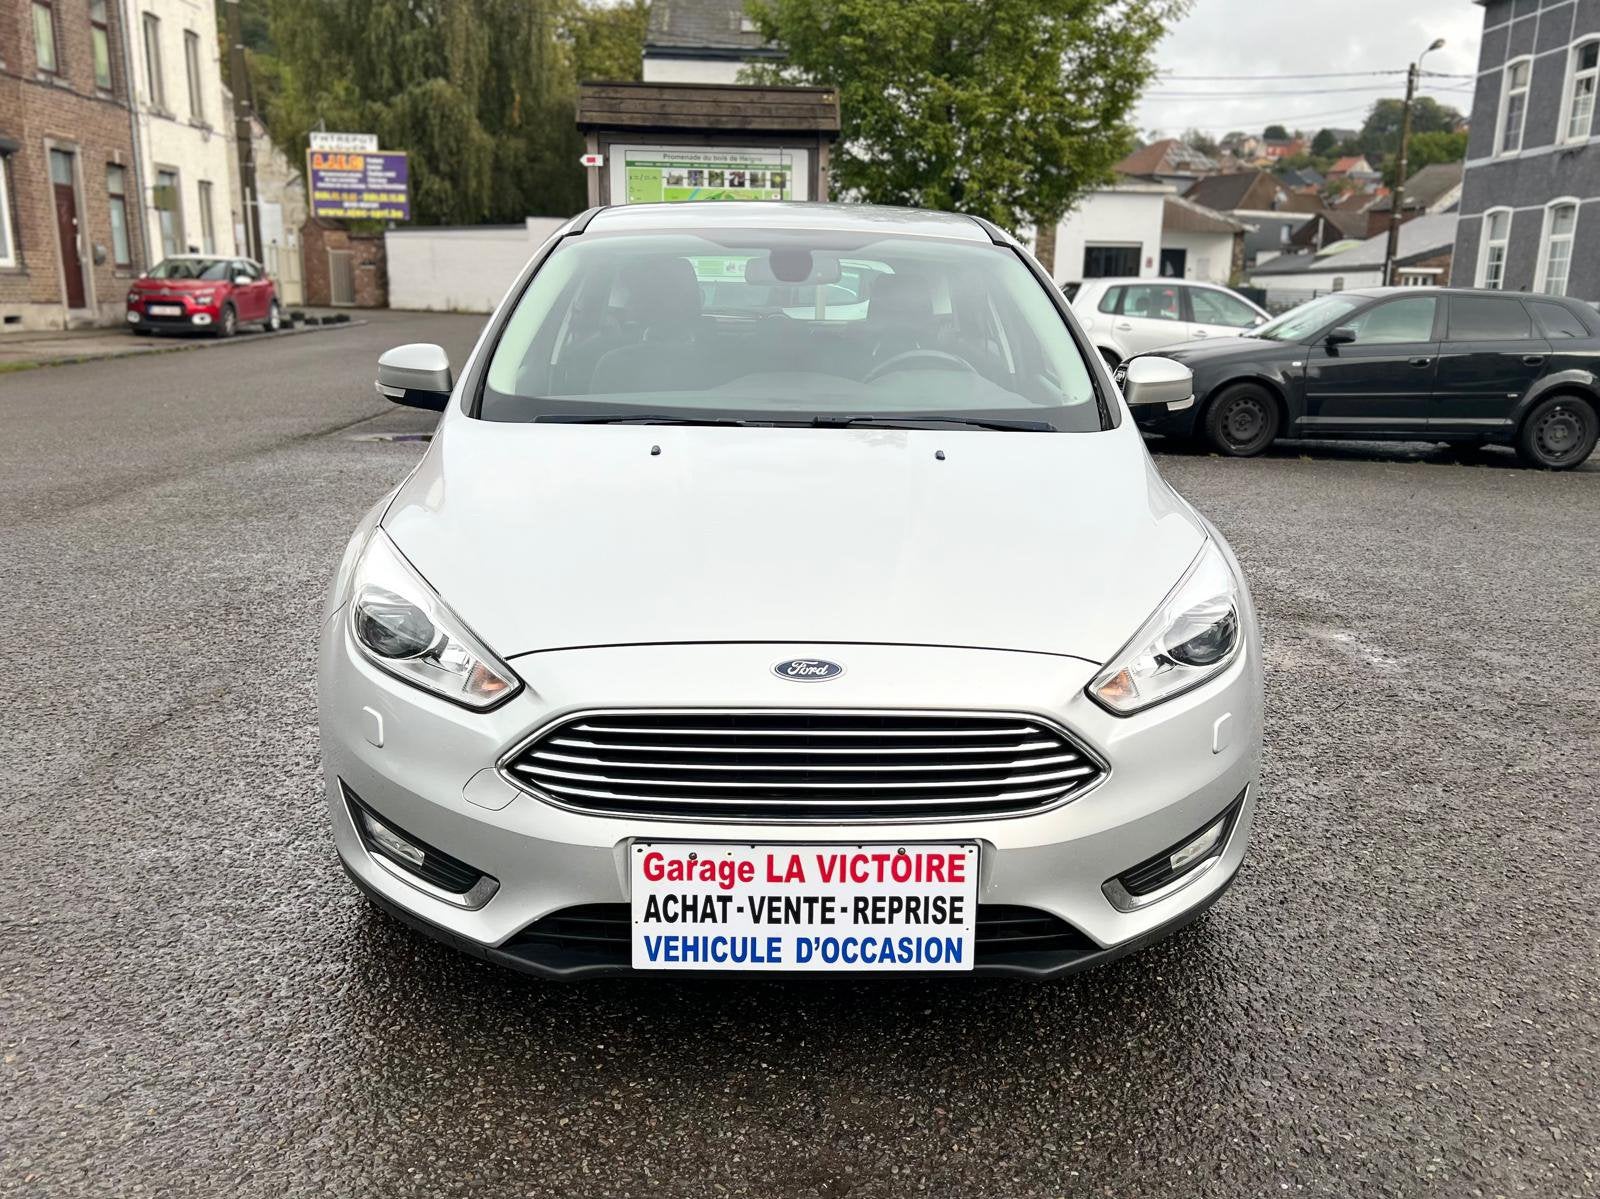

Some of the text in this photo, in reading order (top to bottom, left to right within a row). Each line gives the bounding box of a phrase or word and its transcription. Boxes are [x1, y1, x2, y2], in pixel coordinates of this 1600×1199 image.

[663, 153, 701, 161] Promenade
[787, 660, 829, 675] Ford
[643, 852, 966, 890] Garage LA VICTOIRE
[643, 894, 733, 924] ACHAT
[748, 896, 836, 925] VENTE
[853, 896, 964, 925] REPRISE
[644, 935, 782, 963] VEHICULE
